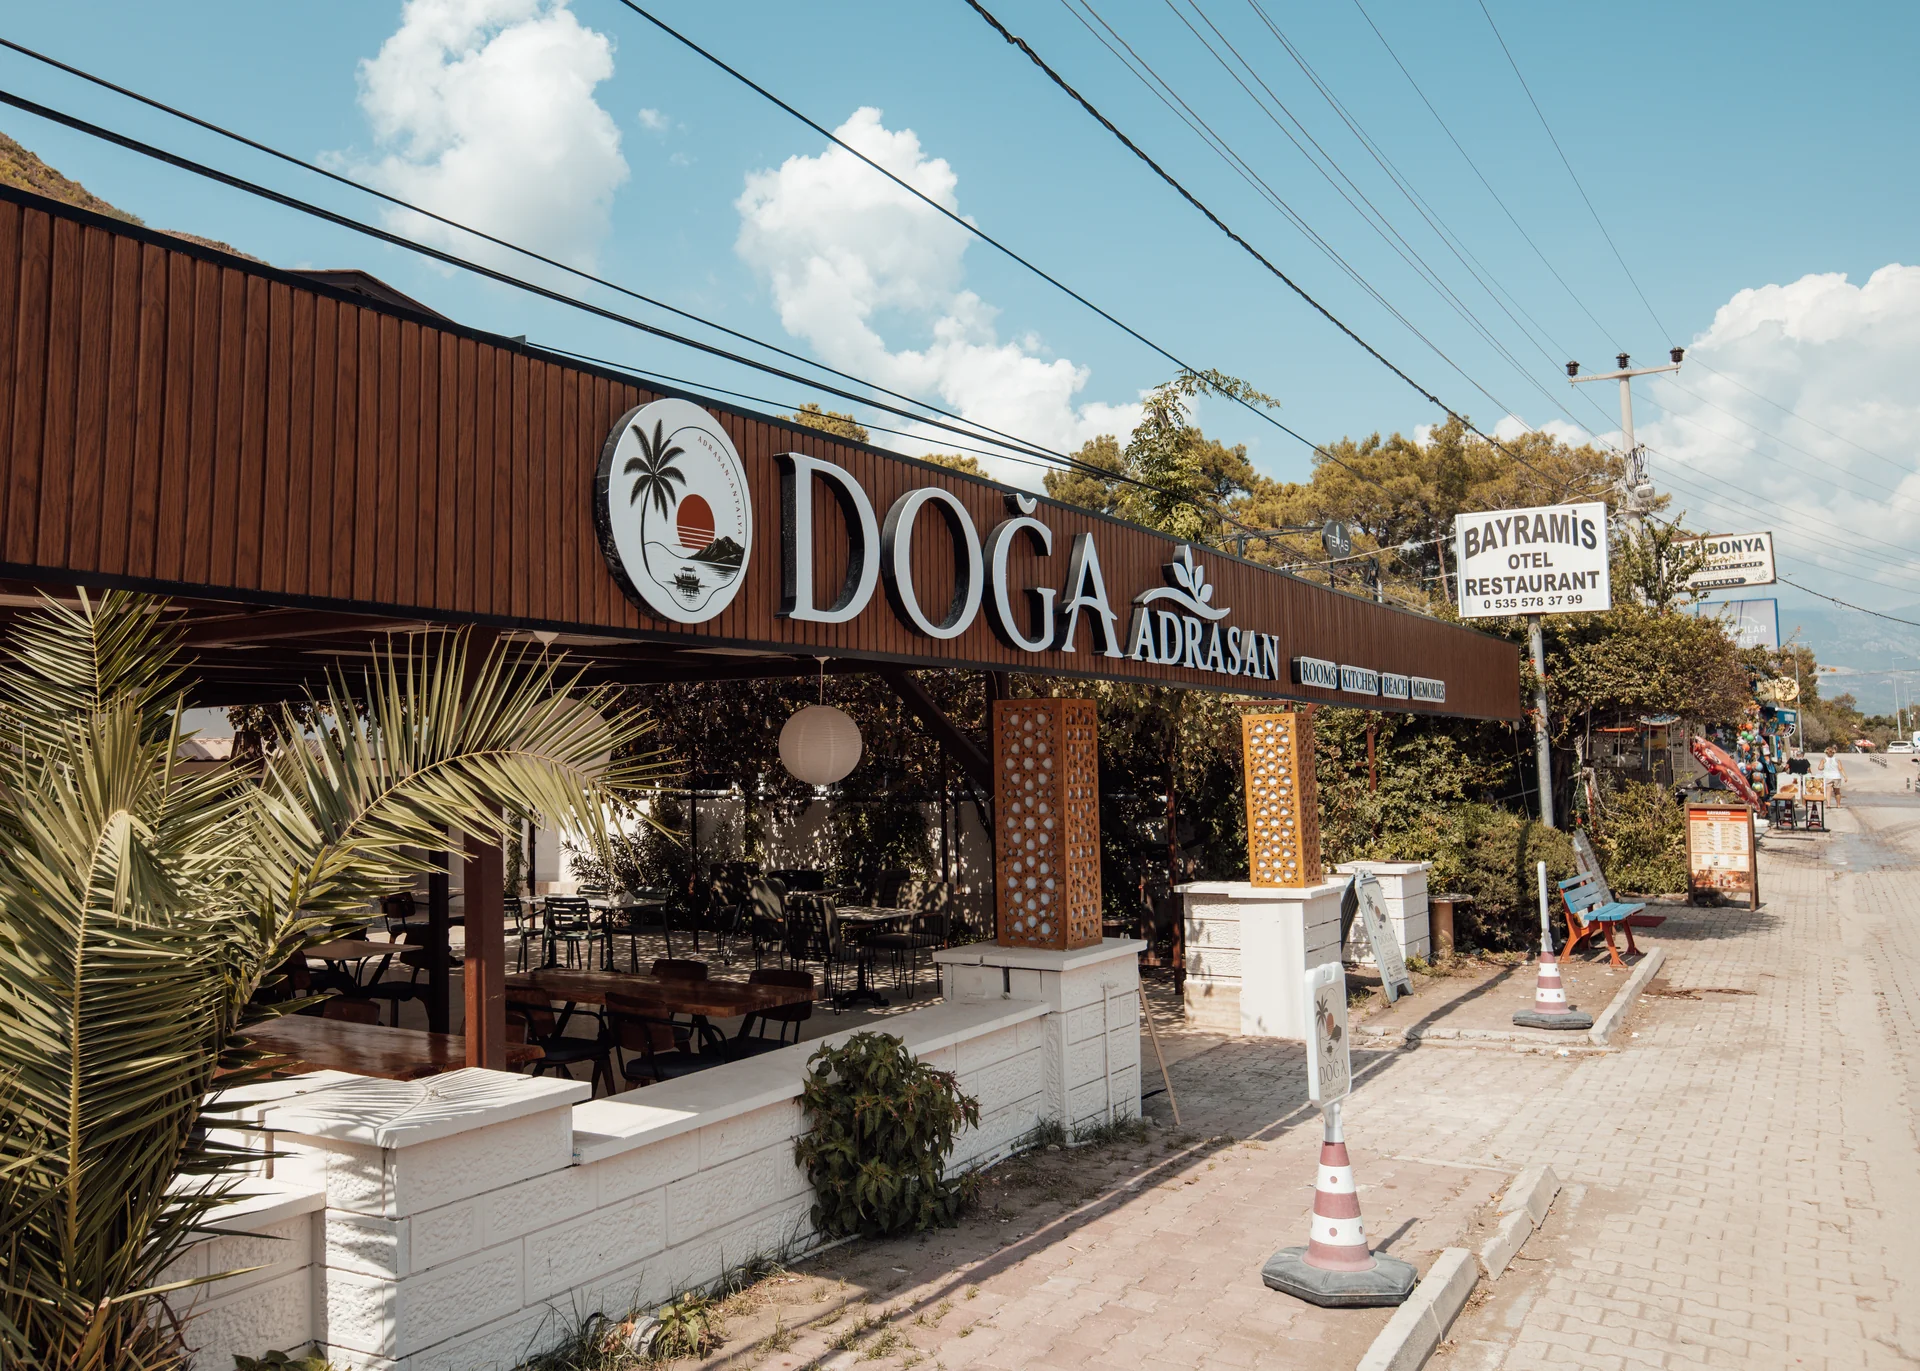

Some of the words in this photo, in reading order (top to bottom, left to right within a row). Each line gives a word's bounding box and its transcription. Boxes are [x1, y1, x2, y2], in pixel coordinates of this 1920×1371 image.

[1464, 509, 1597, 560] BAYRAMİS
[776, 452, 1123, 658] DOĞA
[1508, 552, 1553, 570] OTEL
[1465, 570, 1600, 597] RESTAURANT
[1484, 599, 1491, 609] 0
[1495, 598, 1517, 609] 535
[1521, 597, 1544, 607] 578
[1548, 595, 1563, 606] 37
[1567, 594, 1583, 605] 99
[1131, 607, 1279, 681] ADRASAN
[1302, 661, 1336, 686] ROOMS
[1342, 669, 1378, 692] KITCHEN
[1384, 676, 1408, 697] BEACH
[1412, 680, 1445, 700] MEMORIES
